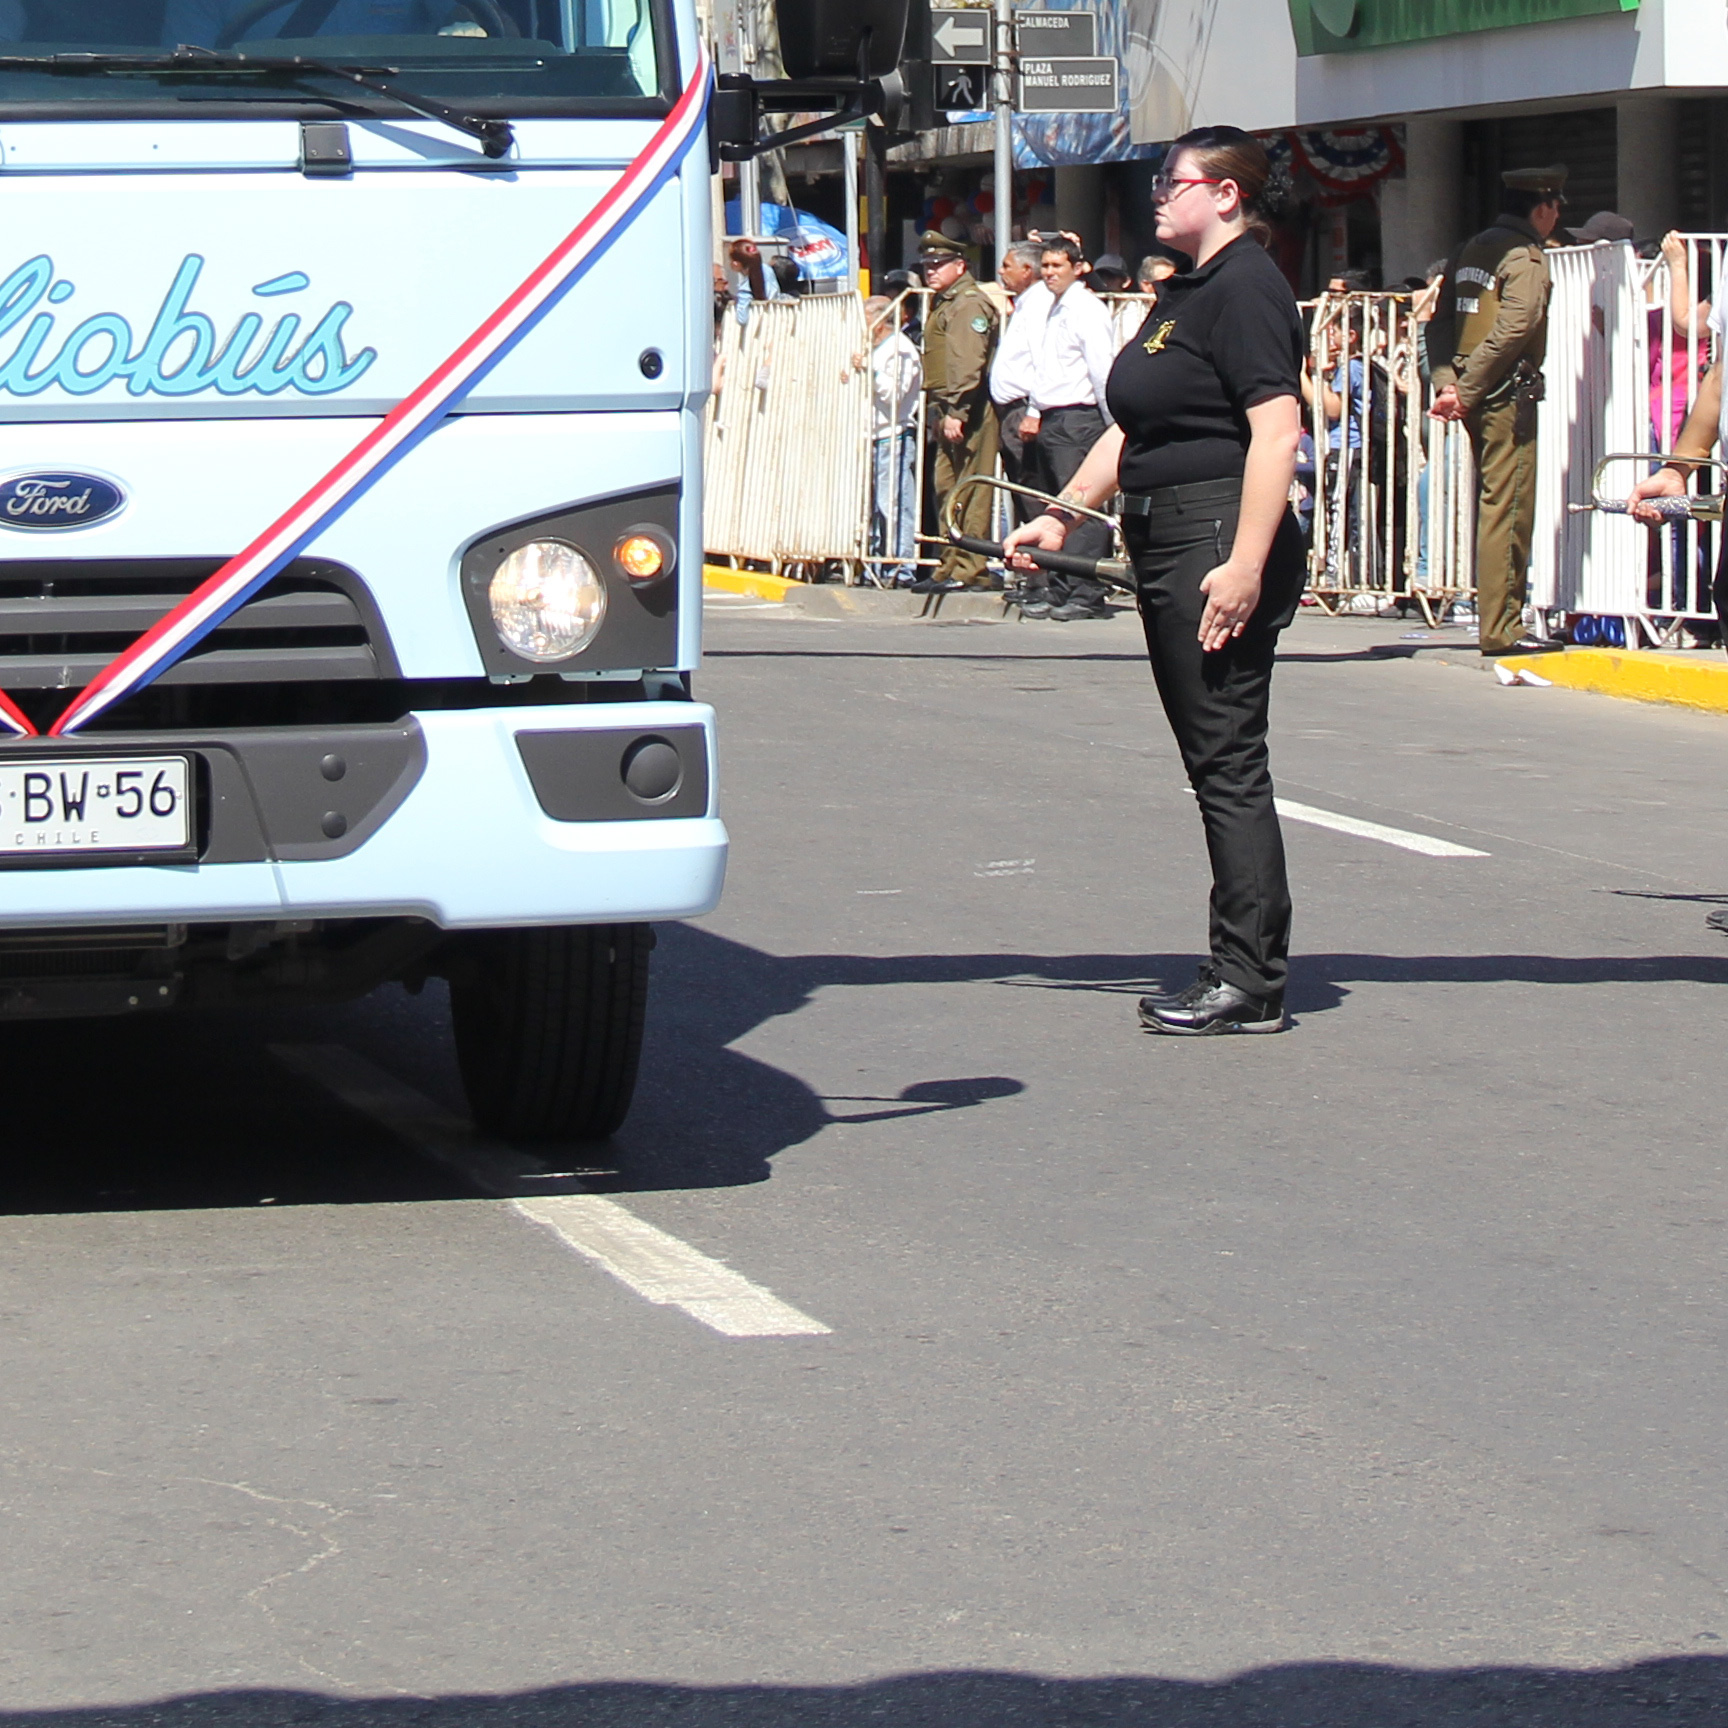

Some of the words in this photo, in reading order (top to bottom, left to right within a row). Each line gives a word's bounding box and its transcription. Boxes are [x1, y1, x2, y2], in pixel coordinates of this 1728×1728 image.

[1024, 62, 1054, 75] PLAZA
[1024, 74, 1060, 87] MANUEL
[1061, 73, 1112, 86] RODRIGUEZ
[6, 479, 93, 516] Ford
[15, 829, 101, 846] CHILE
